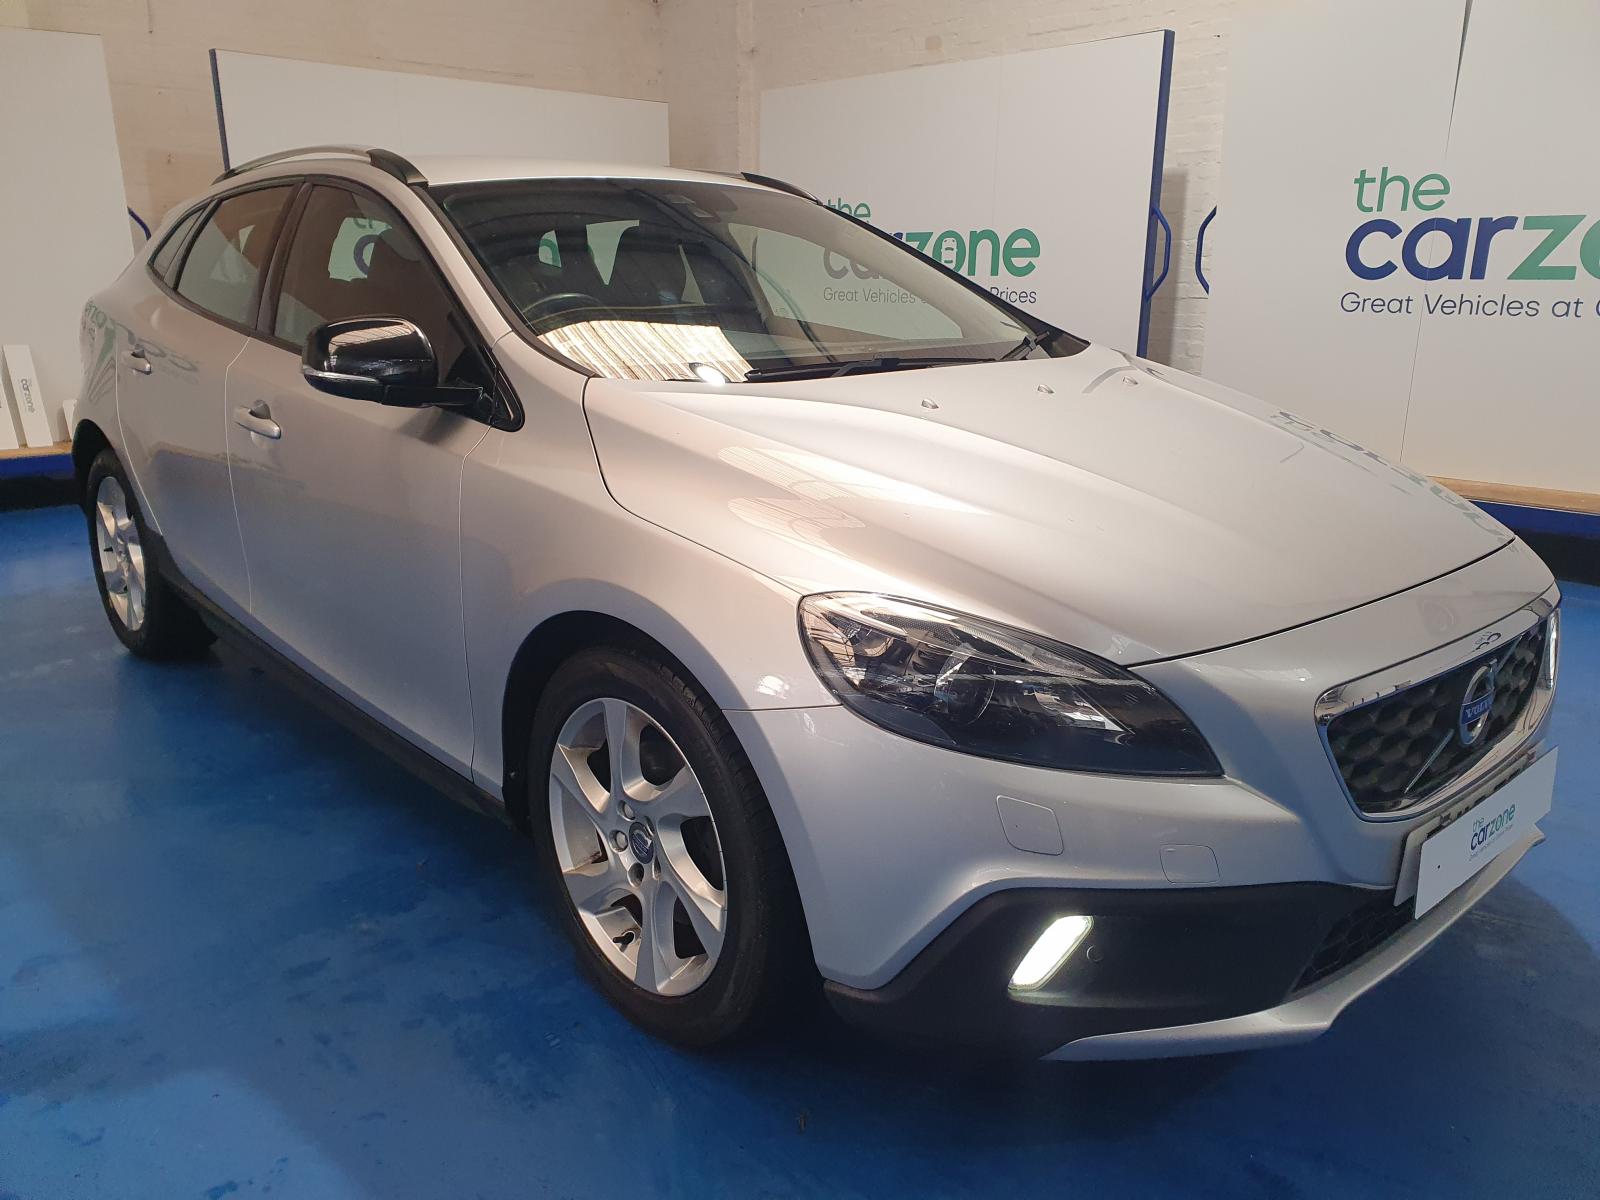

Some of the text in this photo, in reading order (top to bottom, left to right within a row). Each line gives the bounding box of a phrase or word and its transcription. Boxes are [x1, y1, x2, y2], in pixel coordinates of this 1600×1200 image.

[1353, 166, 1450, 212] the
[823, 287, 859, 302] Great
[862, 288, 916, 304] Vehicles
[990, 286, 1037, 304] Prices
[1340, 291, 1413, 314] Great
[1424, 293, 1540, 317] Vehicles
[1551, 297, 1584, 318] at
[1470, 804, 1516, 851] carzone
